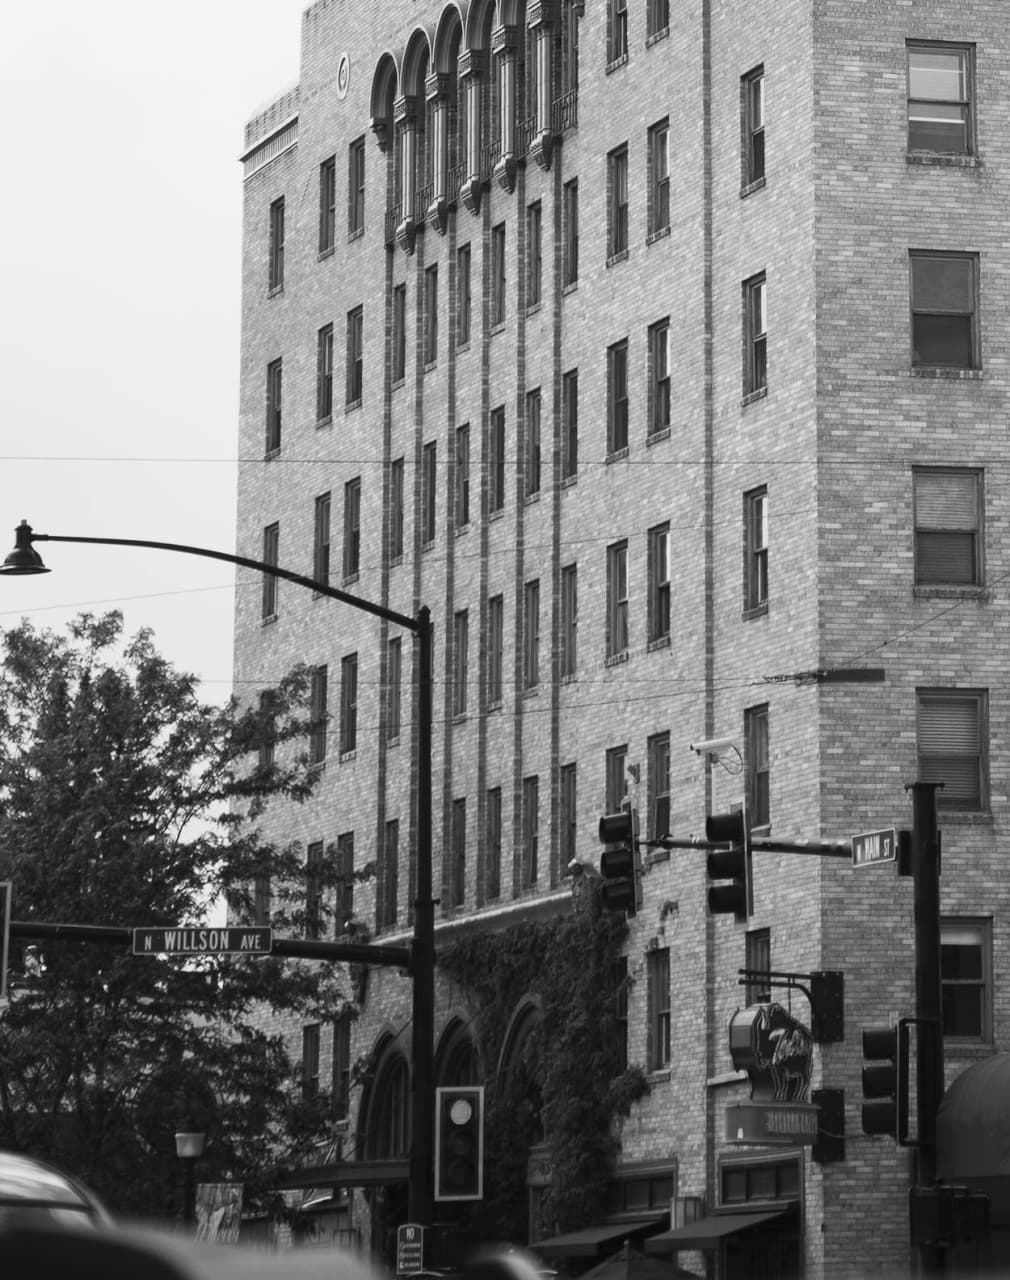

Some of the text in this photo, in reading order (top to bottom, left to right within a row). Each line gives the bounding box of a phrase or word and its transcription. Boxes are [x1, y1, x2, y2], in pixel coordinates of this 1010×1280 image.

[144, 930, 261, 951] N WILLSON AVE
